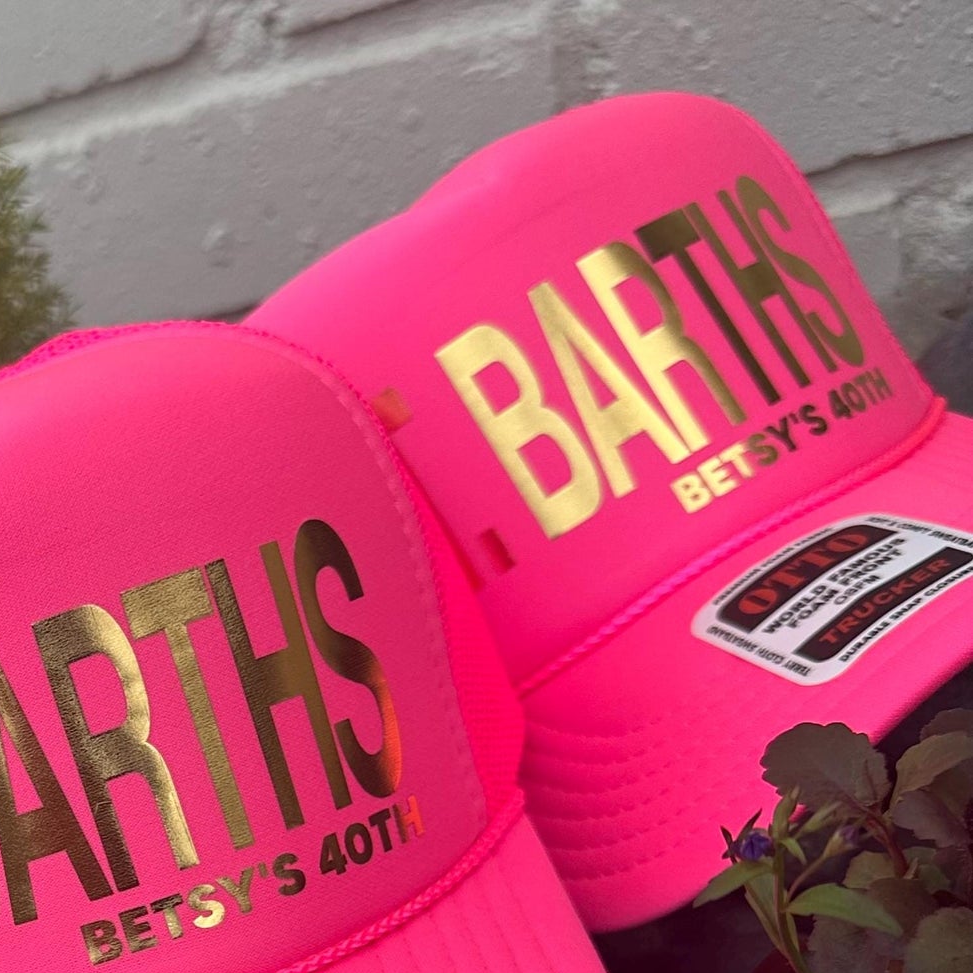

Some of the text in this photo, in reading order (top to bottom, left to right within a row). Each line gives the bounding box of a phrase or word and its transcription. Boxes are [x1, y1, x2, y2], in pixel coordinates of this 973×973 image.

[434, 175, 865, 540] BARTHS
[671, 368, 892, 513] BETSY'S 40TH
[738, 533, 868, 615] OTTO
[762, 538, 906, 634] WORLD FAMOUS
[789, 549, 903, 629] FOAM FRONT
[818, 558, 952, 645] TRUCKER
[80, 794, 425, 965] BETSY'S 40TH
